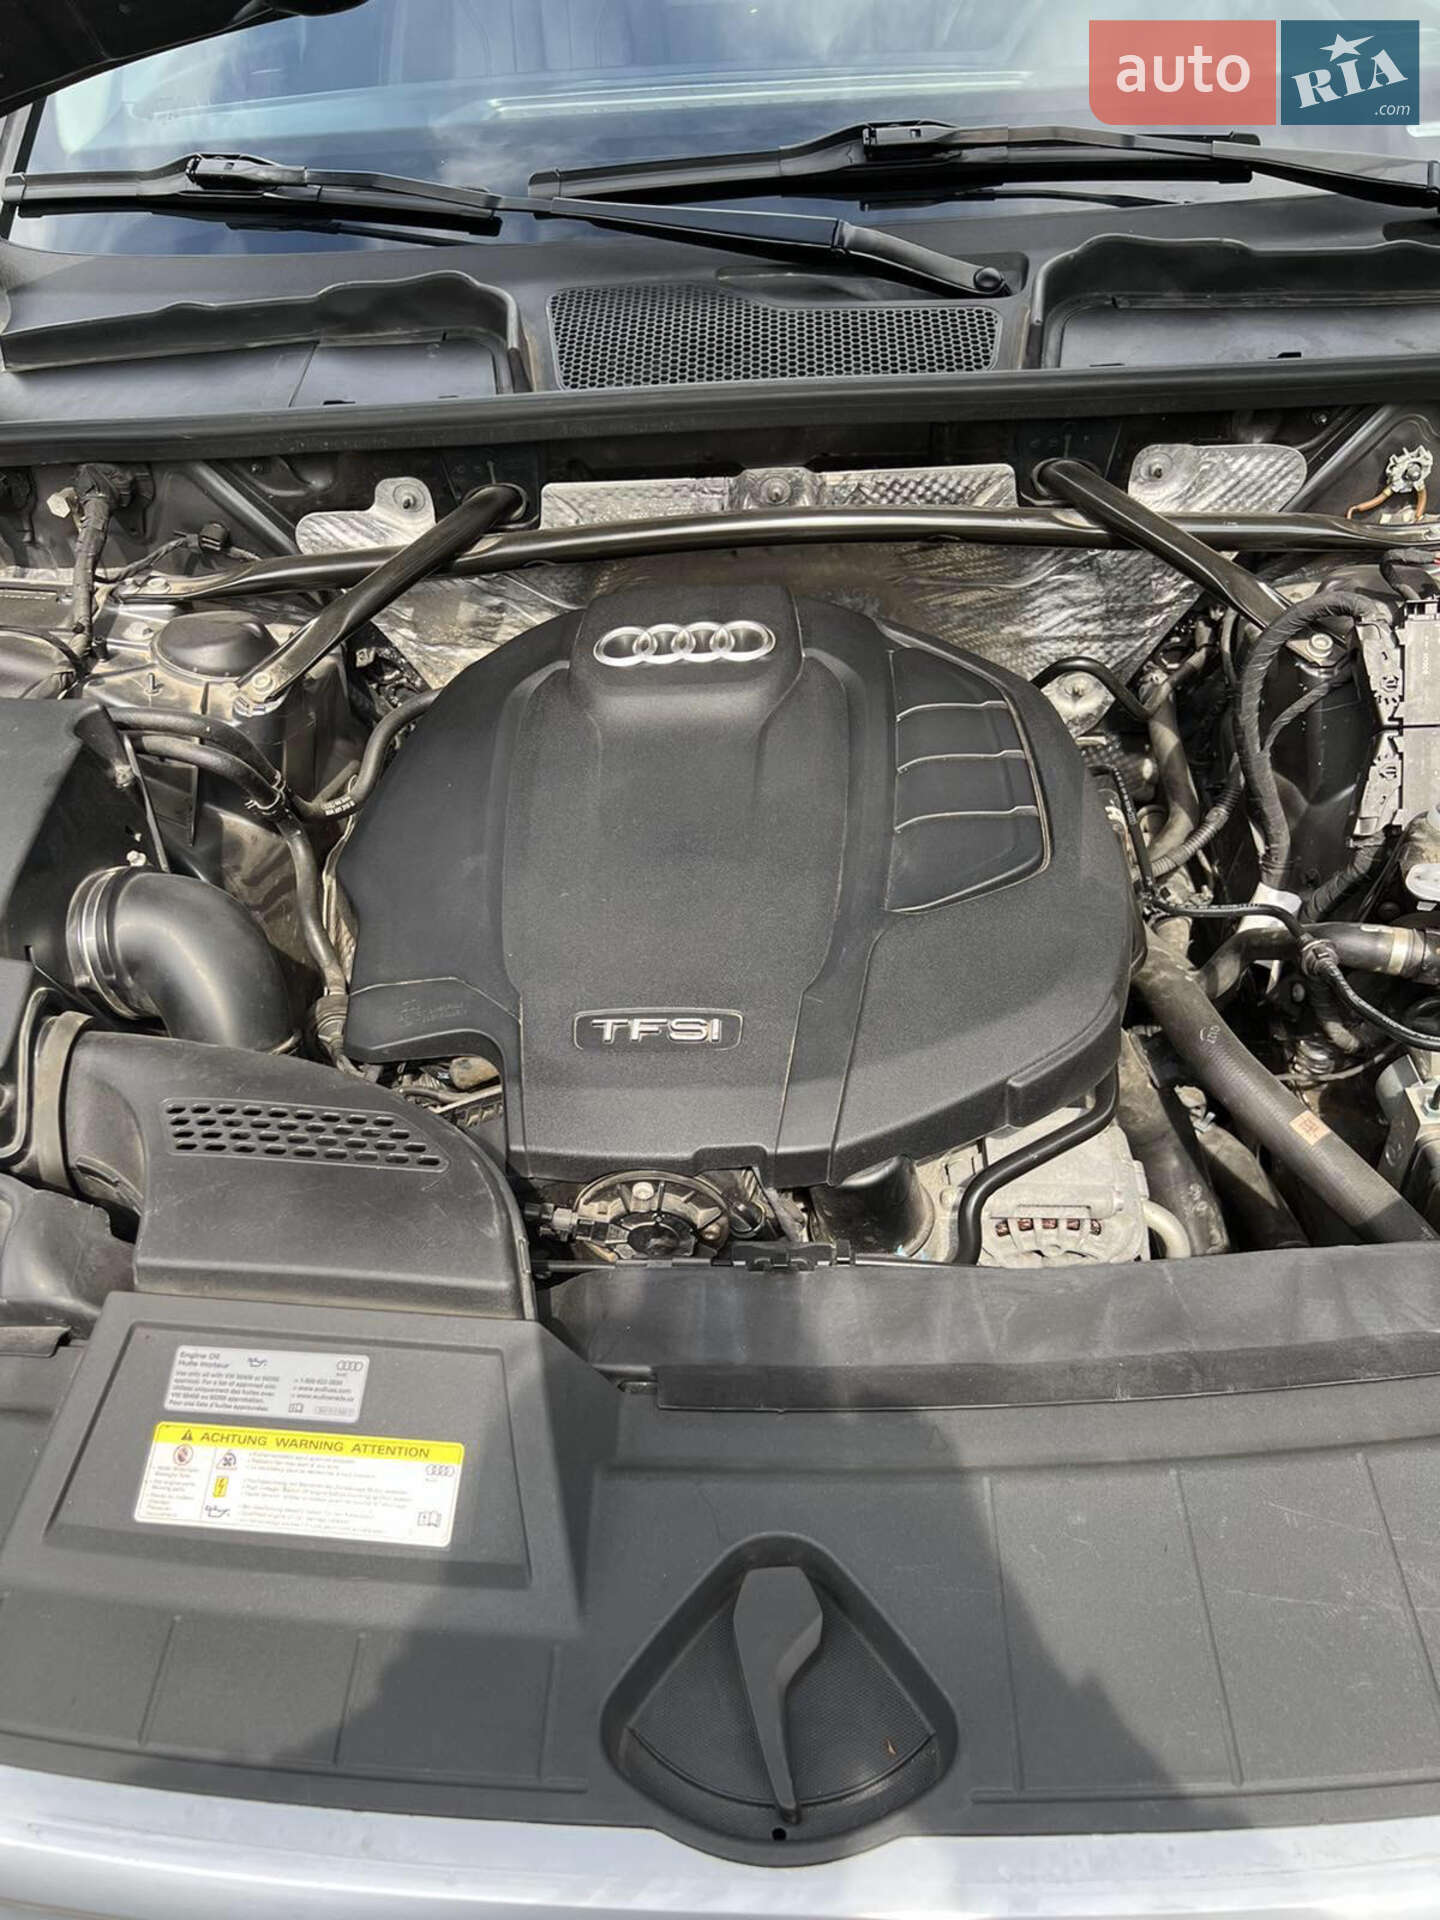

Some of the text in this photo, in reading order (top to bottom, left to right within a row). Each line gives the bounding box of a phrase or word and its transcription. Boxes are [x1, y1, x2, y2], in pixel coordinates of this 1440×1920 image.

[591, 1018, 722, 1044] TFSI
[180, 1351, 207, 1360] Engine
[199, 1432, 268, 1446] ACHTUNG
[275, 1437, 344, 1452] WARNING
[351, 1443, 431, 1459] ATTENTION
